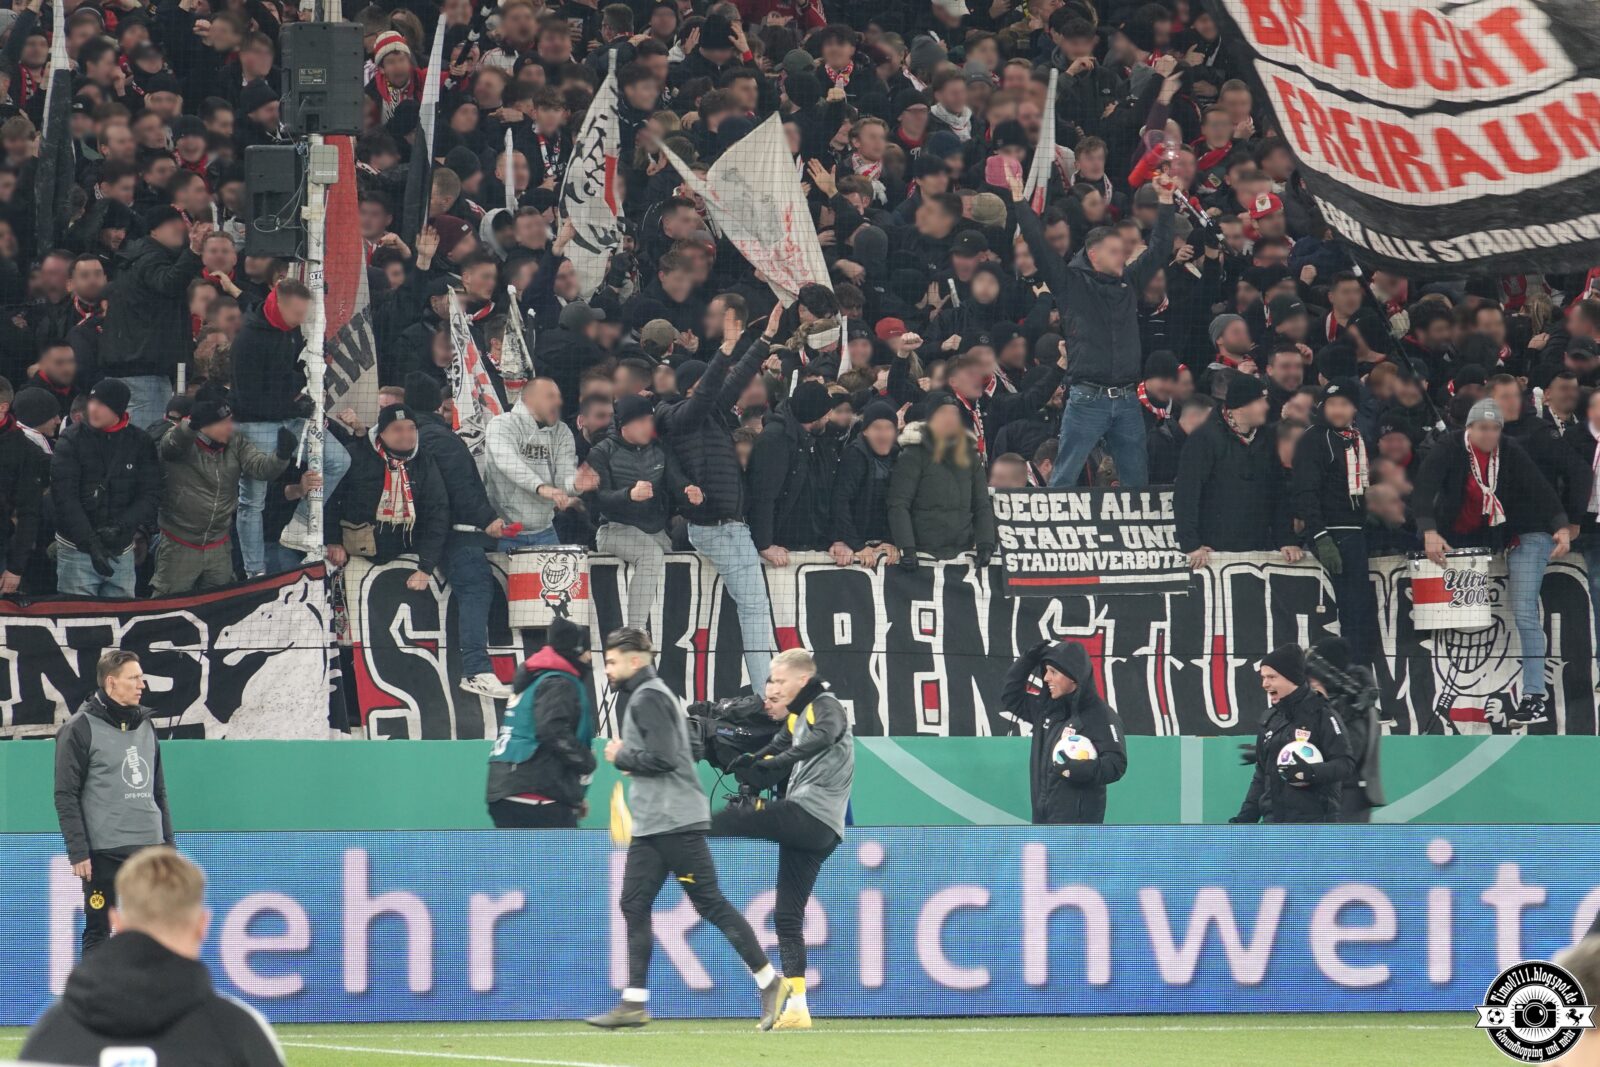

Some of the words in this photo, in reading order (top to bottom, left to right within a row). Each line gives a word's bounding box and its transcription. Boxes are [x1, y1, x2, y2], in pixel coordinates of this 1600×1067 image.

[1242, 0, 1547, 91] BRAUCHT
[1271, 74, 1600, 193] FREIRAUM
[1366, 227, 1438, 263] ALLE
[1428, 211, 1600, 263] STADIONV
[993, 492, 1092, 521] GEGEN
[1100, 491, 1175, 520] ALLE
[997, 524, 1114, 550] STADT-
[1006, 550, 1191, 573] STADIONVERBOTE
[609, 837, 1600, 992] Reichweit
